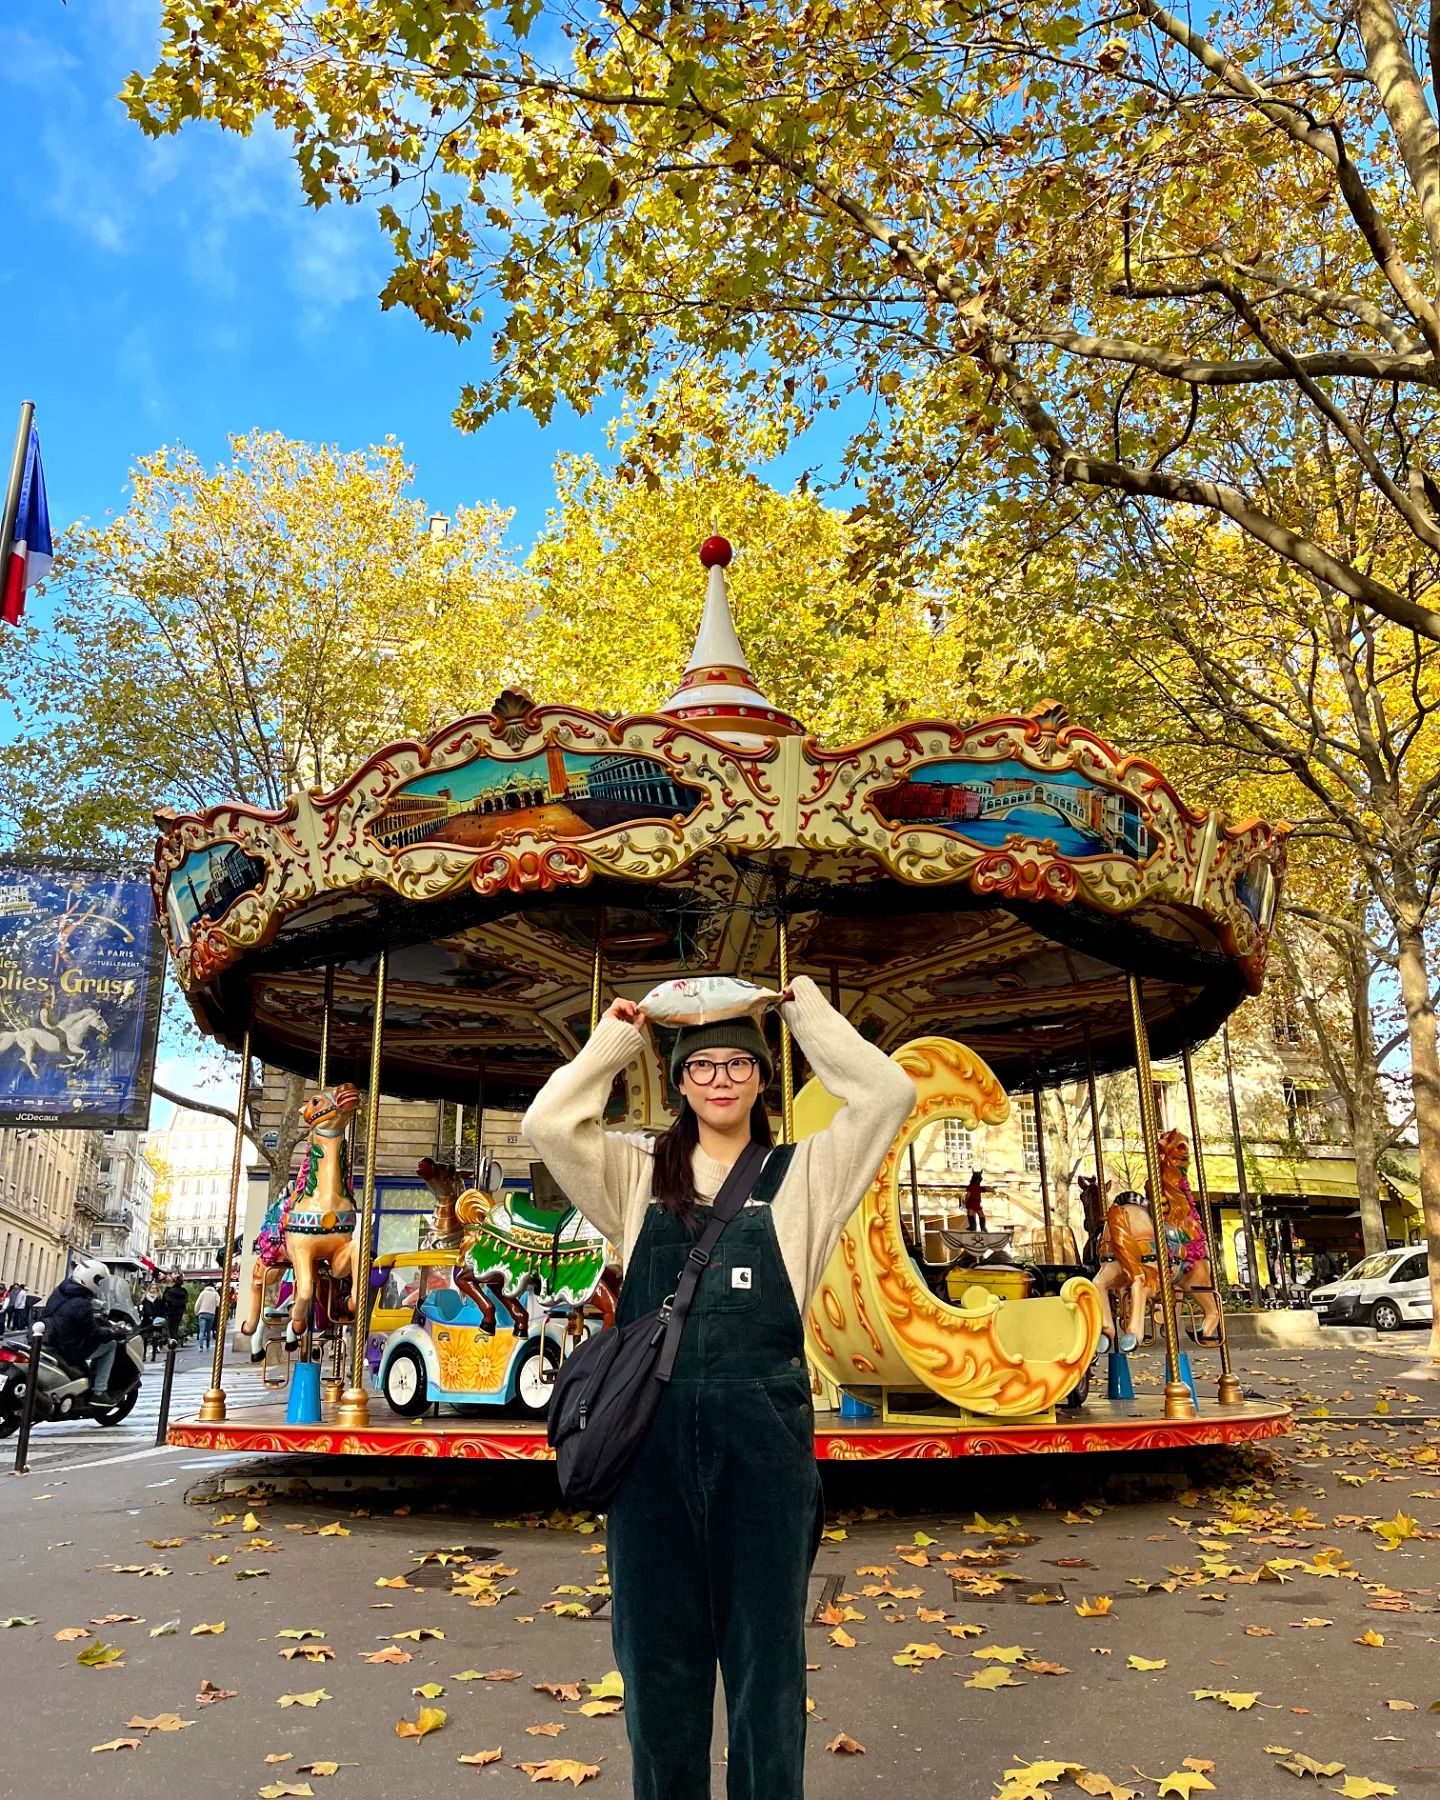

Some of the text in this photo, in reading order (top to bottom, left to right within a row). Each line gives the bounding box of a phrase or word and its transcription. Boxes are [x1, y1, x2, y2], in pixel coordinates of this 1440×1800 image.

[107, 949, 134, 958] PARIS
[88, 960, 140, 968] ACTUELLEMENT
[15, 1112, 59, 1121] JCDecaux
